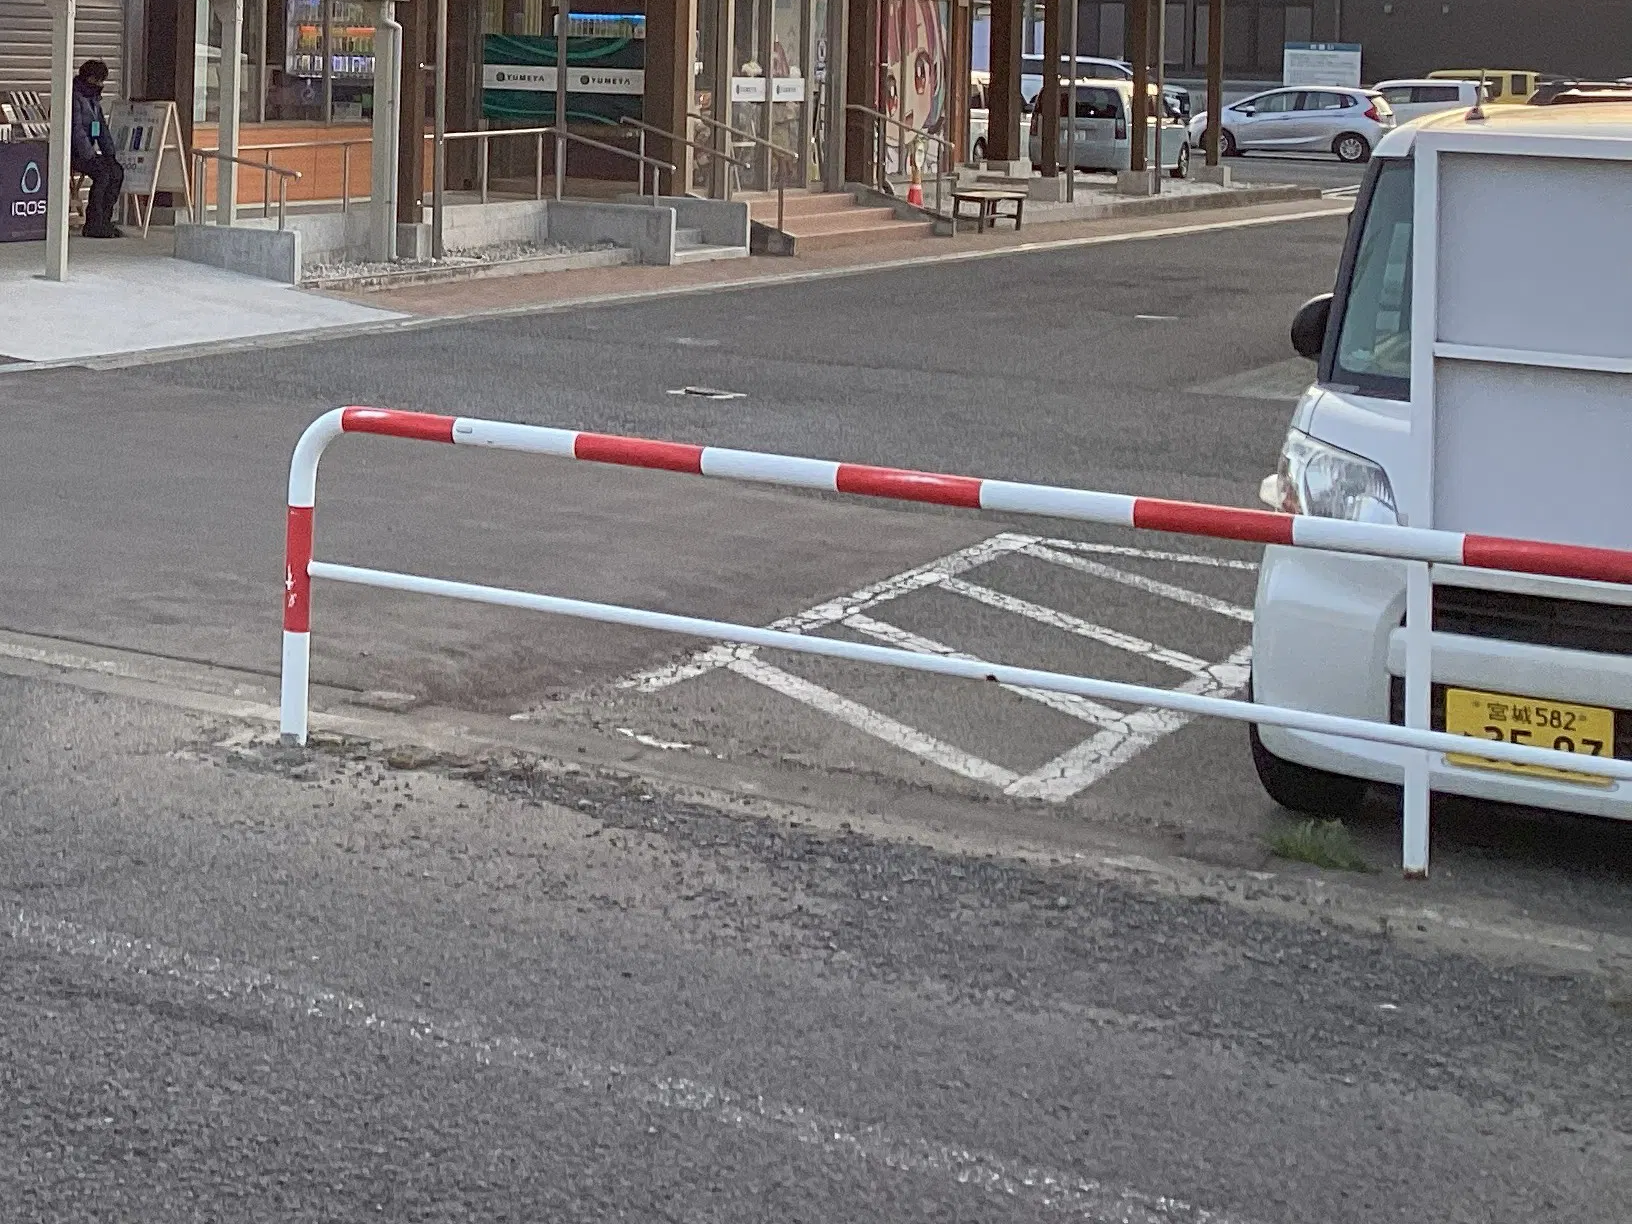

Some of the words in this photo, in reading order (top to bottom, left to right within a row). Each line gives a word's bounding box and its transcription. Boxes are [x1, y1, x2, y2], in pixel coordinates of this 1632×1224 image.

[506, 73, 545, 83] YUMEYA
[591, 77, 631, 86] YUMEYA
[11, 200, 47, 216] IQOS
